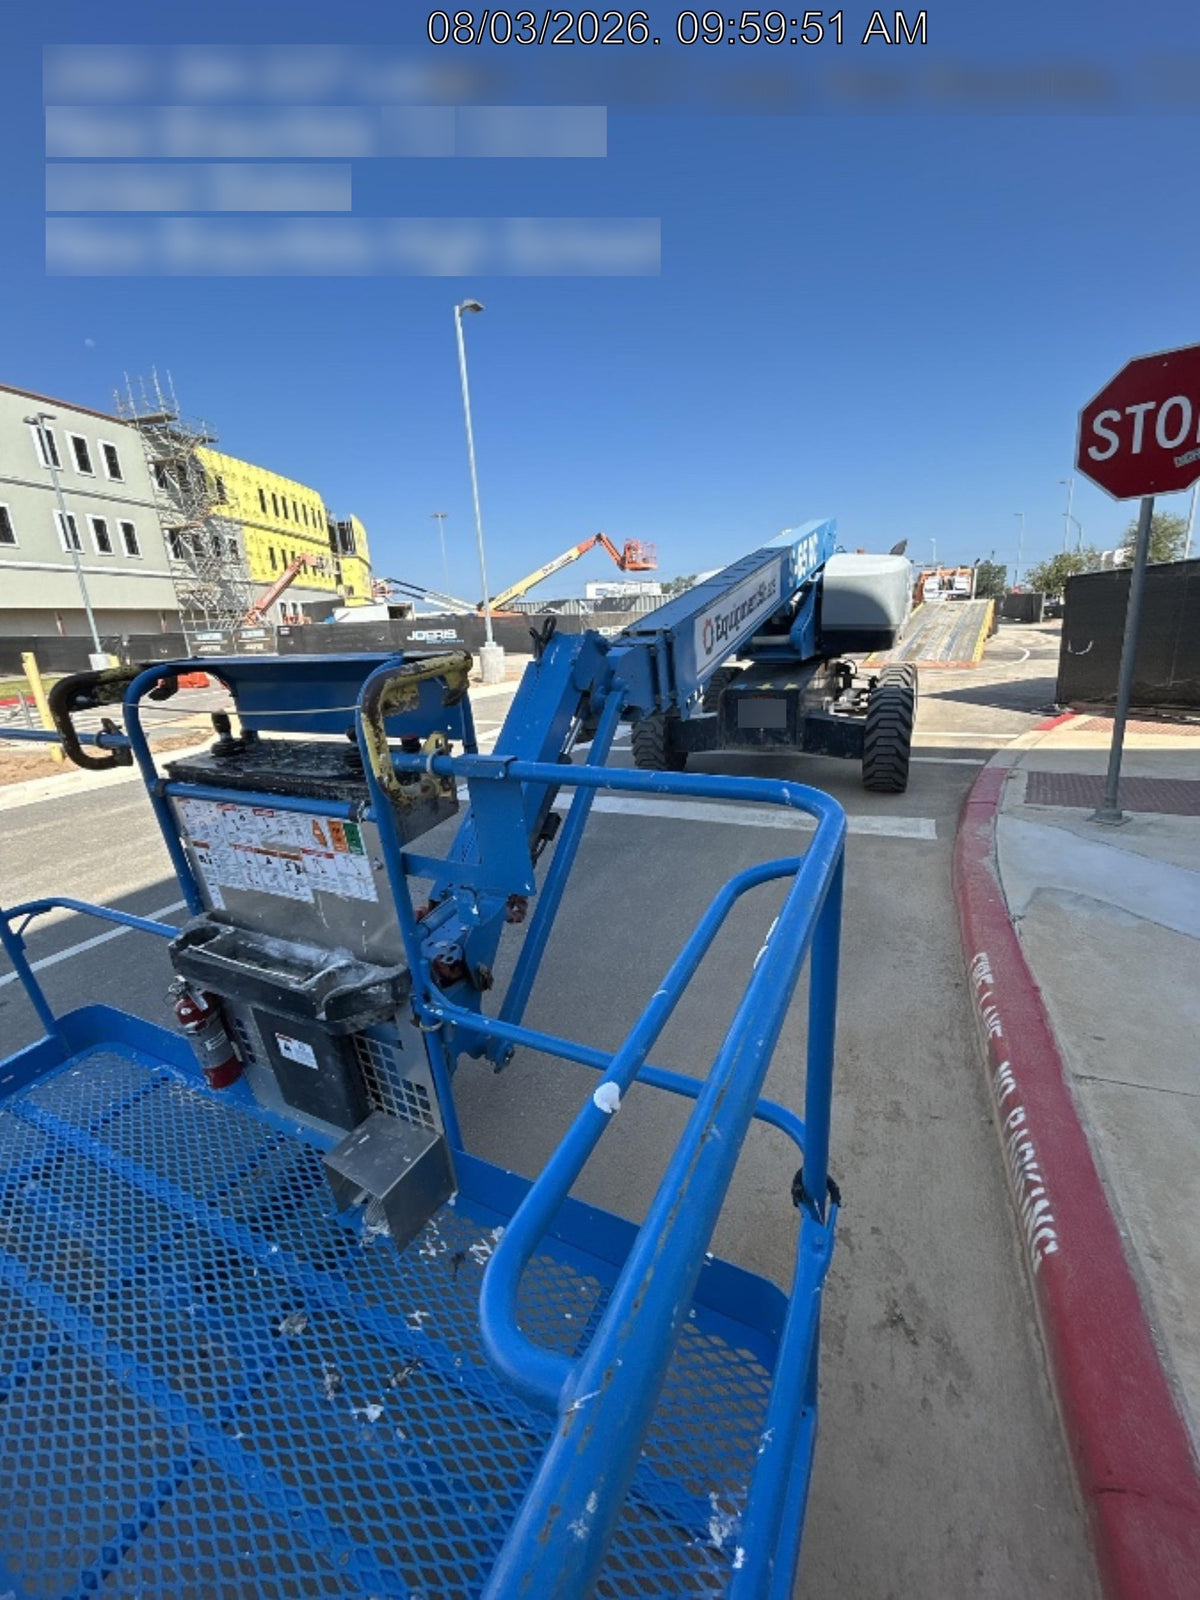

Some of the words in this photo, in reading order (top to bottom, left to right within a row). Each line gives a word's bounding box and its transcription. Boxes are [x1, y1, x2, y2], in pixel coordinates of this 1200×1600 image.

[1088, 396, 1200, 461] STO
[995, 1060, 1016, 1107] NO
[1002, 1105, 1059, 1273] PARKING
